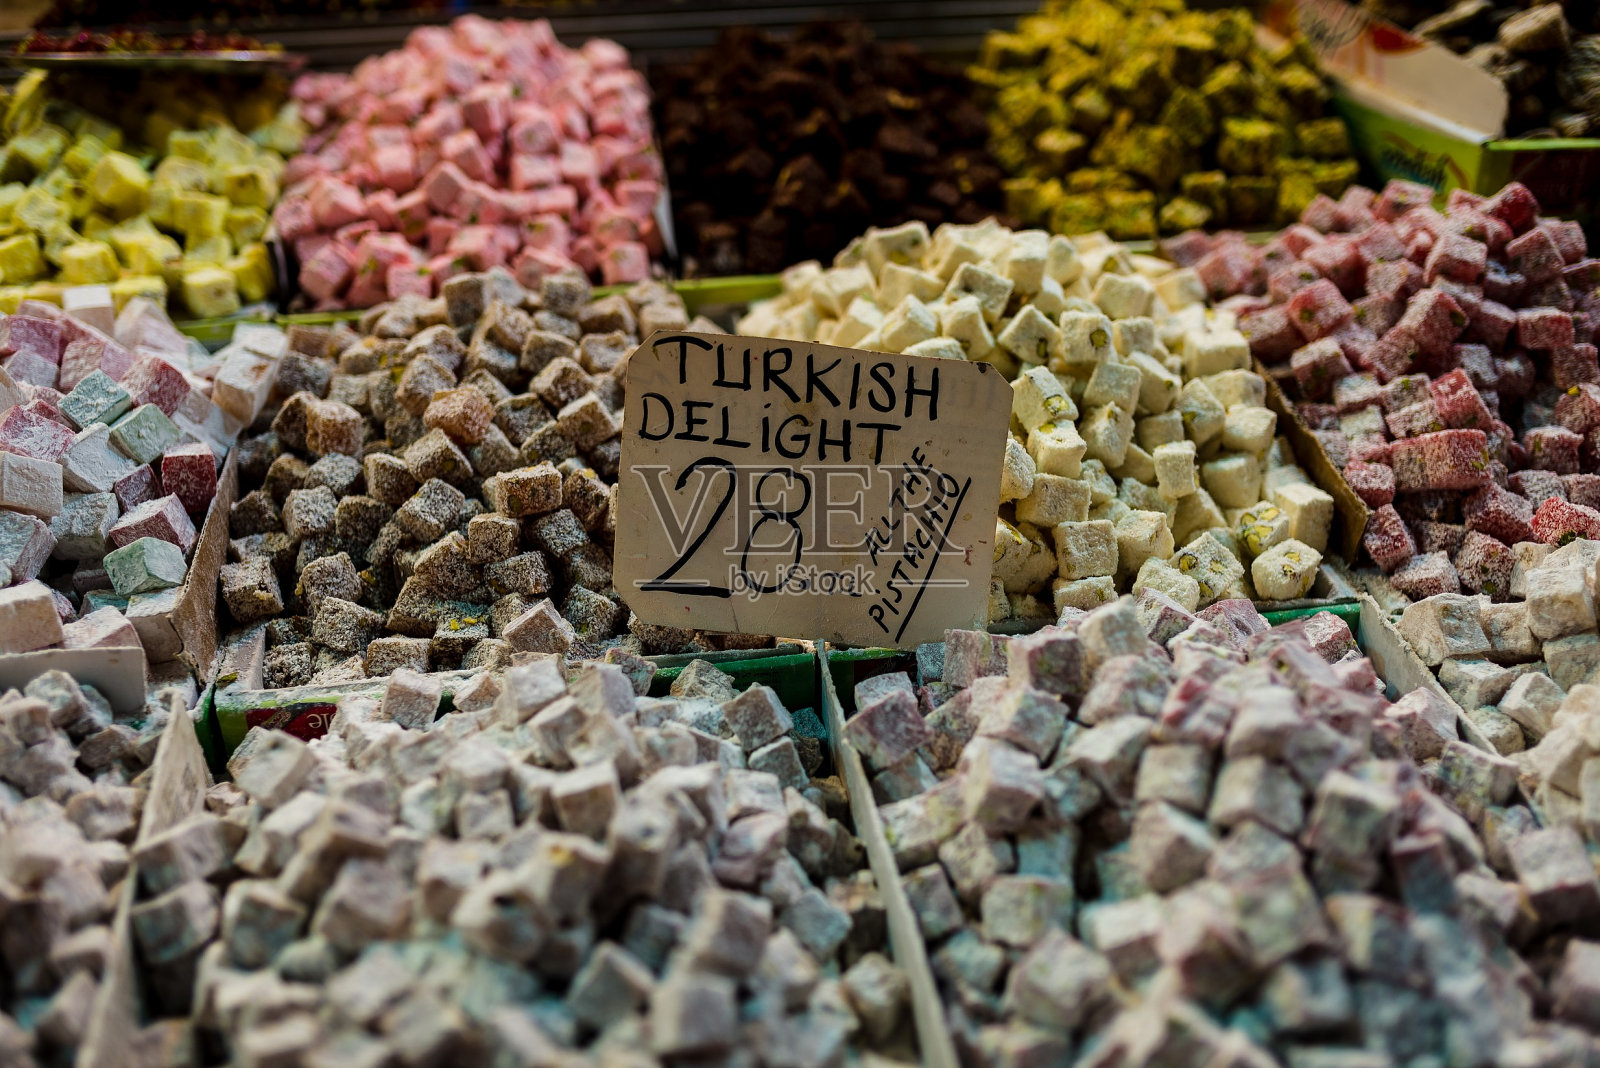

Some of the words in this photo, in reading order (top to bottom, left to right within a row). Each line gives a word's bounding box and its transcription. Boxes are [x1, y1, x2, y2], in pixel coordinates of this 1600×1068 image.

[652, 336, 939, 420] TURKISH
[865, 516, 900, 566] ALL
[889, 447, 933, 511] THE
